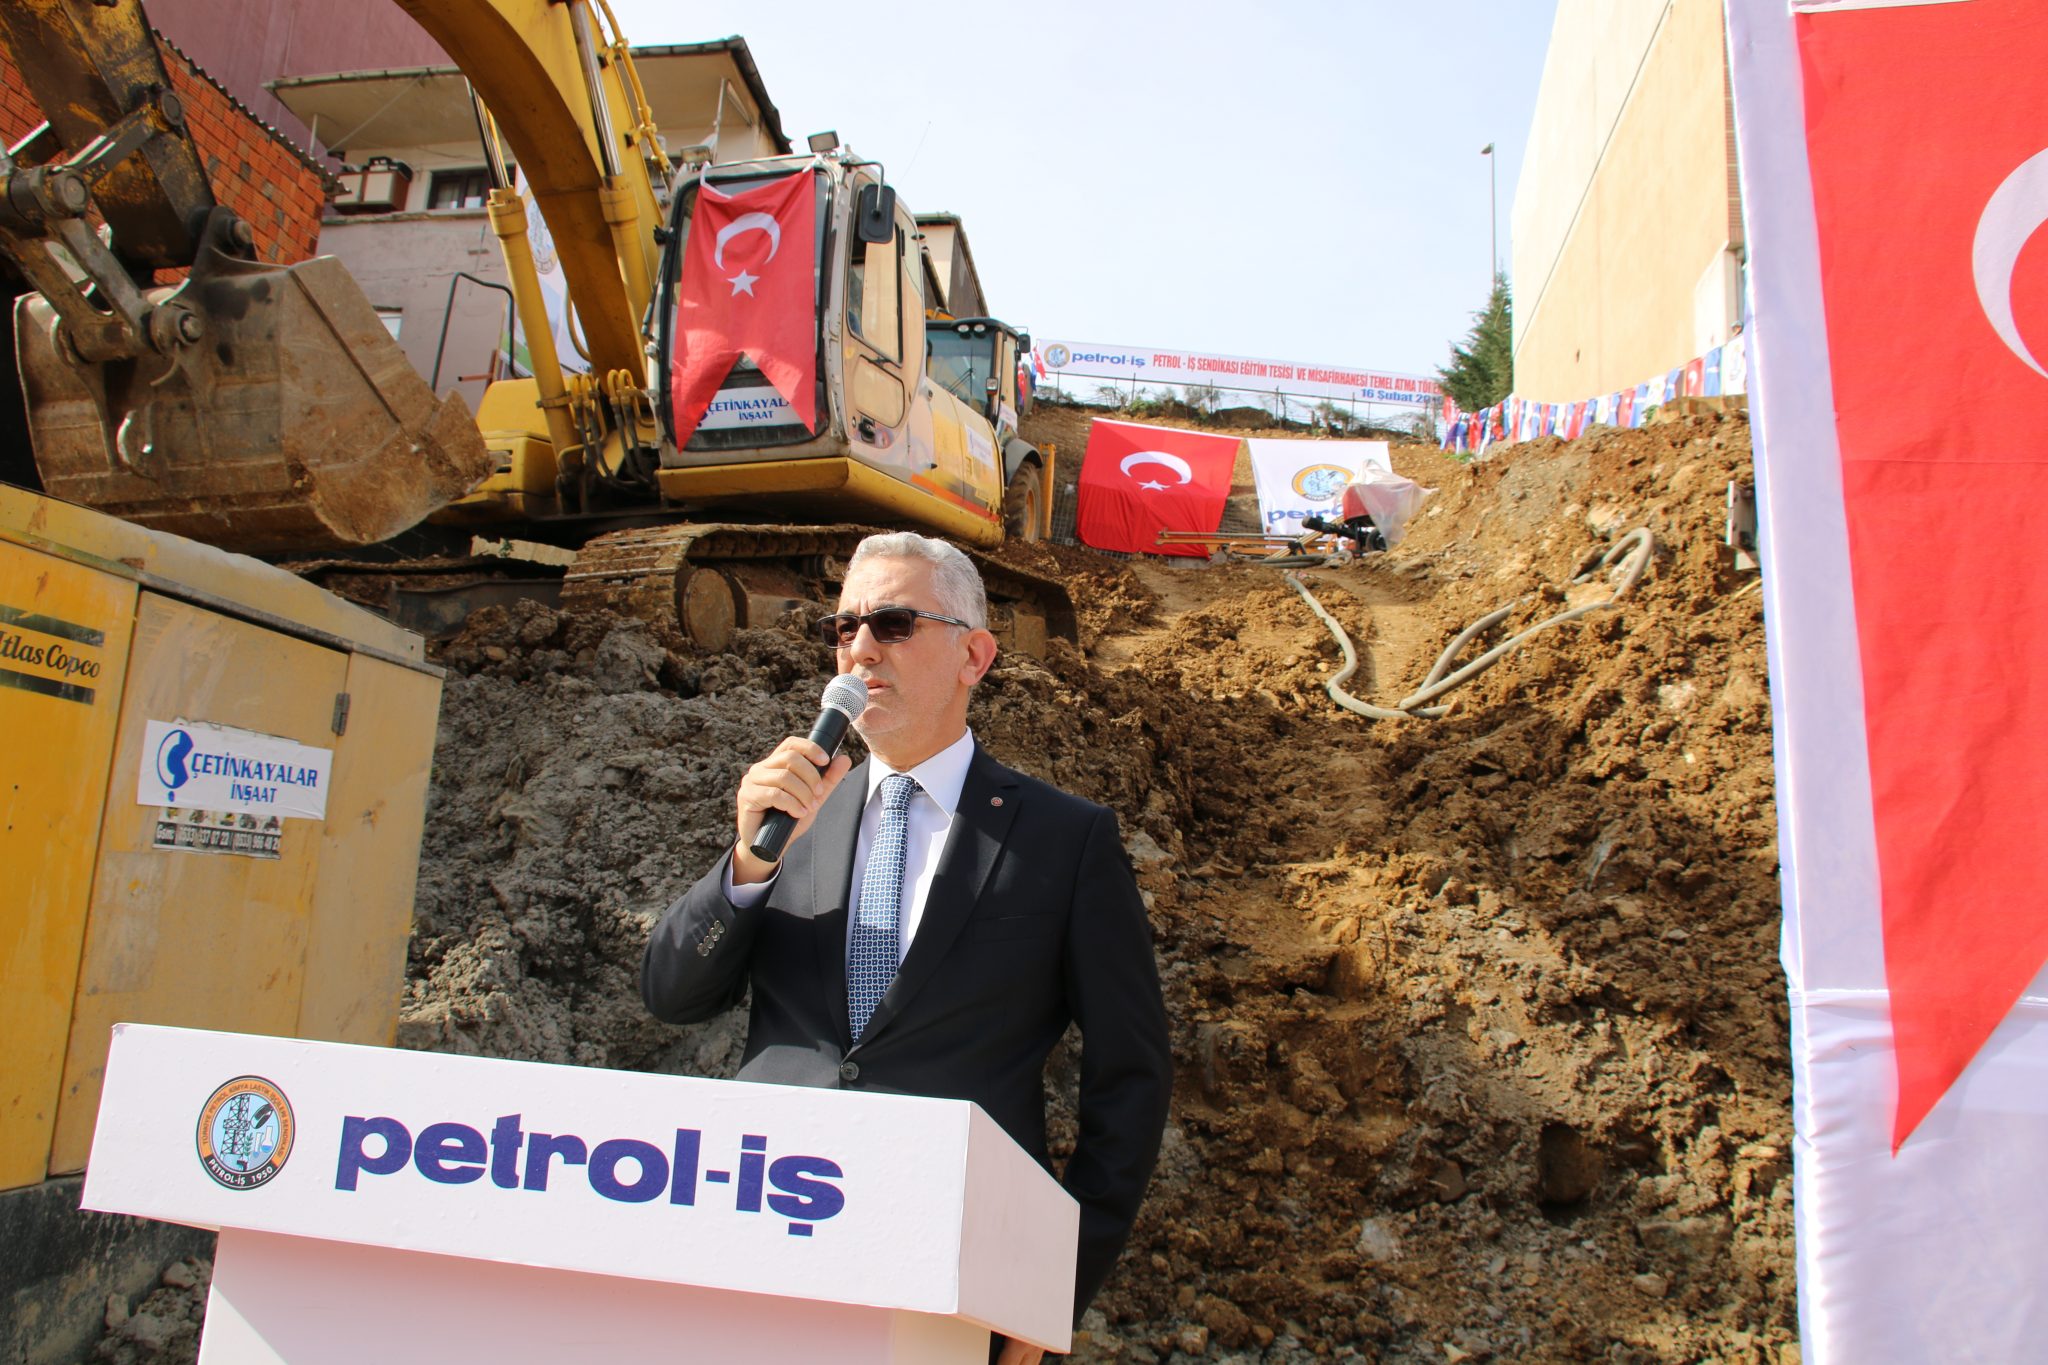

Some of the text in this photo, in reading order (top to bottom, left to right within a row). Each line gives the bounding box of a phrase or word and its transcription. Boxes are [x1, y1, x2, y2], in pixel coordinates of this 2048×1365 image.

[1072, 353, 1145, 368] petrol-iş
[1153, 354, 1181, 369] PETROL
[1187, 357, 1196, 372] İŞ
[1197, 358, 1239, 374] SENDİKASI
[1240, 360, 1267, 377] EĞİTİM
[1269, 364, 1293, 379] TESİSİ
[1297, 368, 1307, 381] VE
[1308, 368, 1368, 387] MİSAFİRHANESİ
[1370, 375, 1393, 389] TEMEL
[1394, 378, 1416, 392] ATMA
[708, 398, 789, 415] ÇETİNKAYAL
[1361, 388, 1374, 398] 16
[1377, 389, 1413, 402] Şubat
[739, 410, 773, 422] İNŞAAT
[46, 644, 100, 678] Copco
[191, 752, 318, 787] ÇETİNKAYALAR
[230, 779, 277, 806] İNŞAAT
[208, 1158, 274, 1187] PETROL-İŞ 1950
[335, 1113, 846, 1237] petrol-iş
